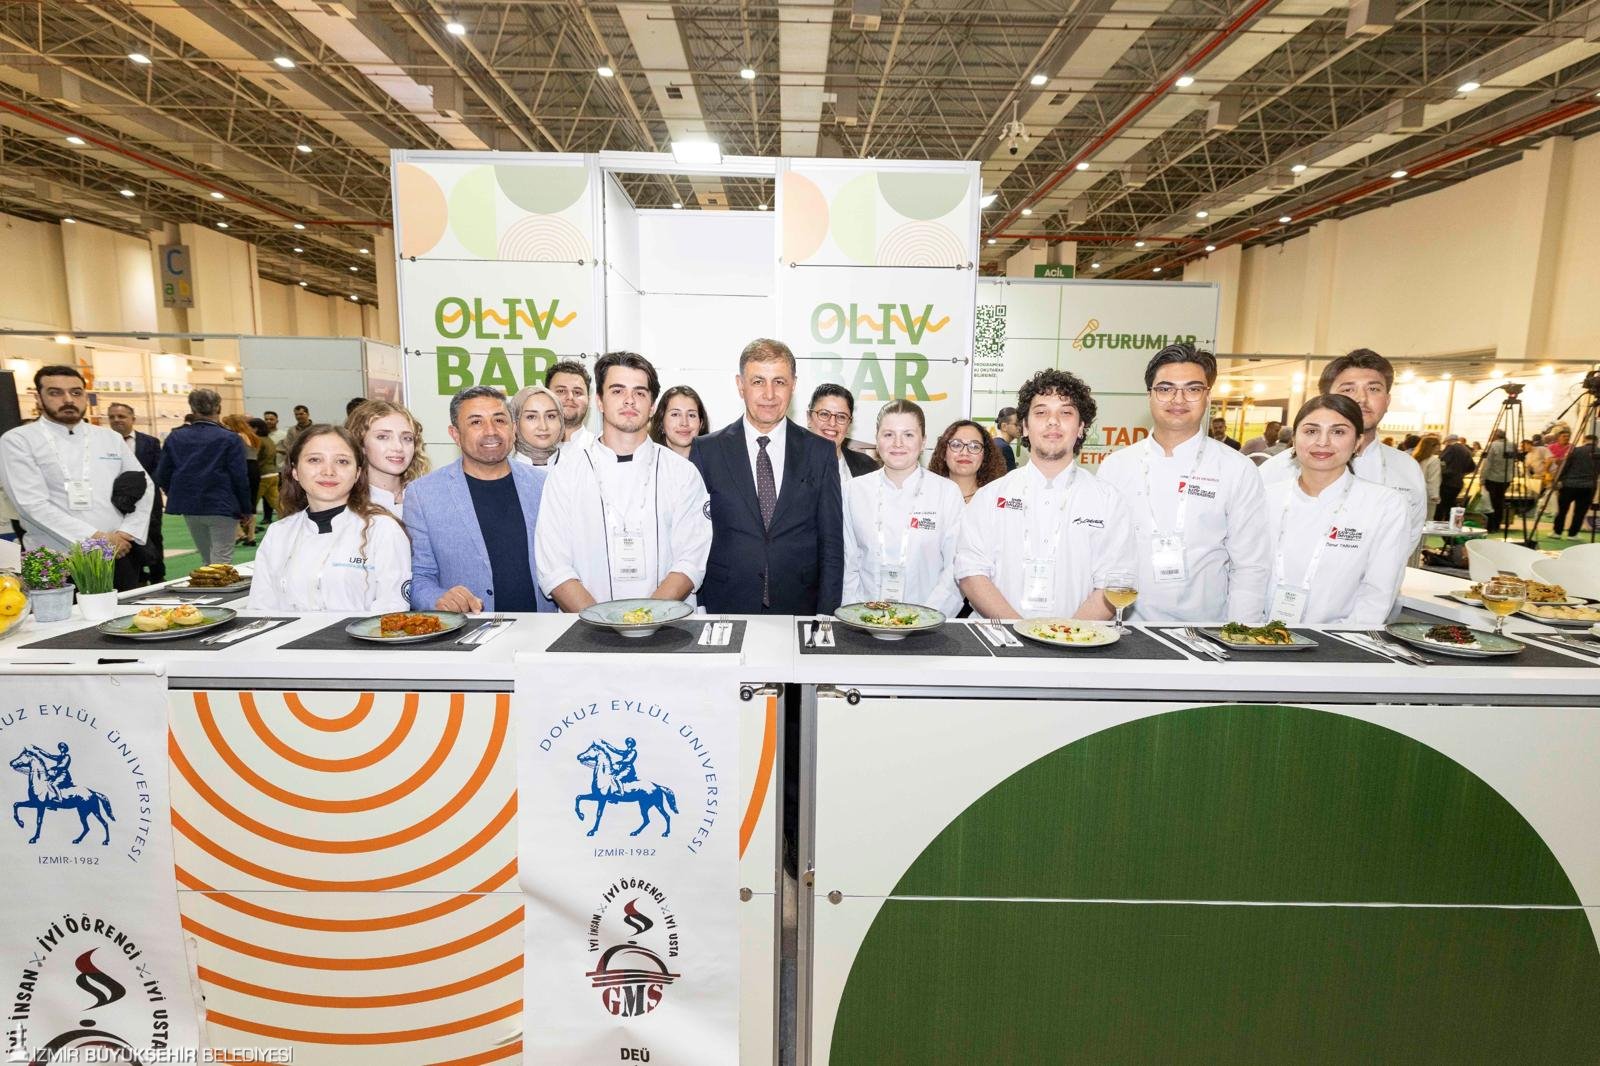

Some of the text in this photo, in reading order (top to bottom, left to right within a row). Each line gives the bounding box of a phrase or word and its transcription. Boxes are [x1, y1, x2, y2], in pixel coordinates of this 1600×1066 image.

[167, 249, 184, 276] C
[1044, 267, 1065, 278] ACİL
[435, 296, 560, 341] OLIV
[810, 302, 935, 346] OLIV
[436, 346, 559, 397] BAR
[810, 351, 933, 402] BAR
[1080, 449, 1112, 465] ETK
[39, 704, 98, 730] EYLÜL
[539, 703, 600, 751] DOKUZ
[611, 700, 672, 725] EYLÜL
[36, 921, 65, 953] İYİ
[63, 912, 143, 961] ÖĞRENCİ
[588, 914, 602, 937] İNSAN
[602, 883, 620, 903] İYİ
[619, 876, 667, 904] ÖĞRENCİ
[668, 933, 679, 957] USTA
[8, 969, 39, 1020] İNSAN
[143, 980, 167, 1002] İYİ
[602, 983, 663, 1018] GMS
[151, 1009, 169, 1050] USTA
[620, 1047, 650, 1063] DEÜ
